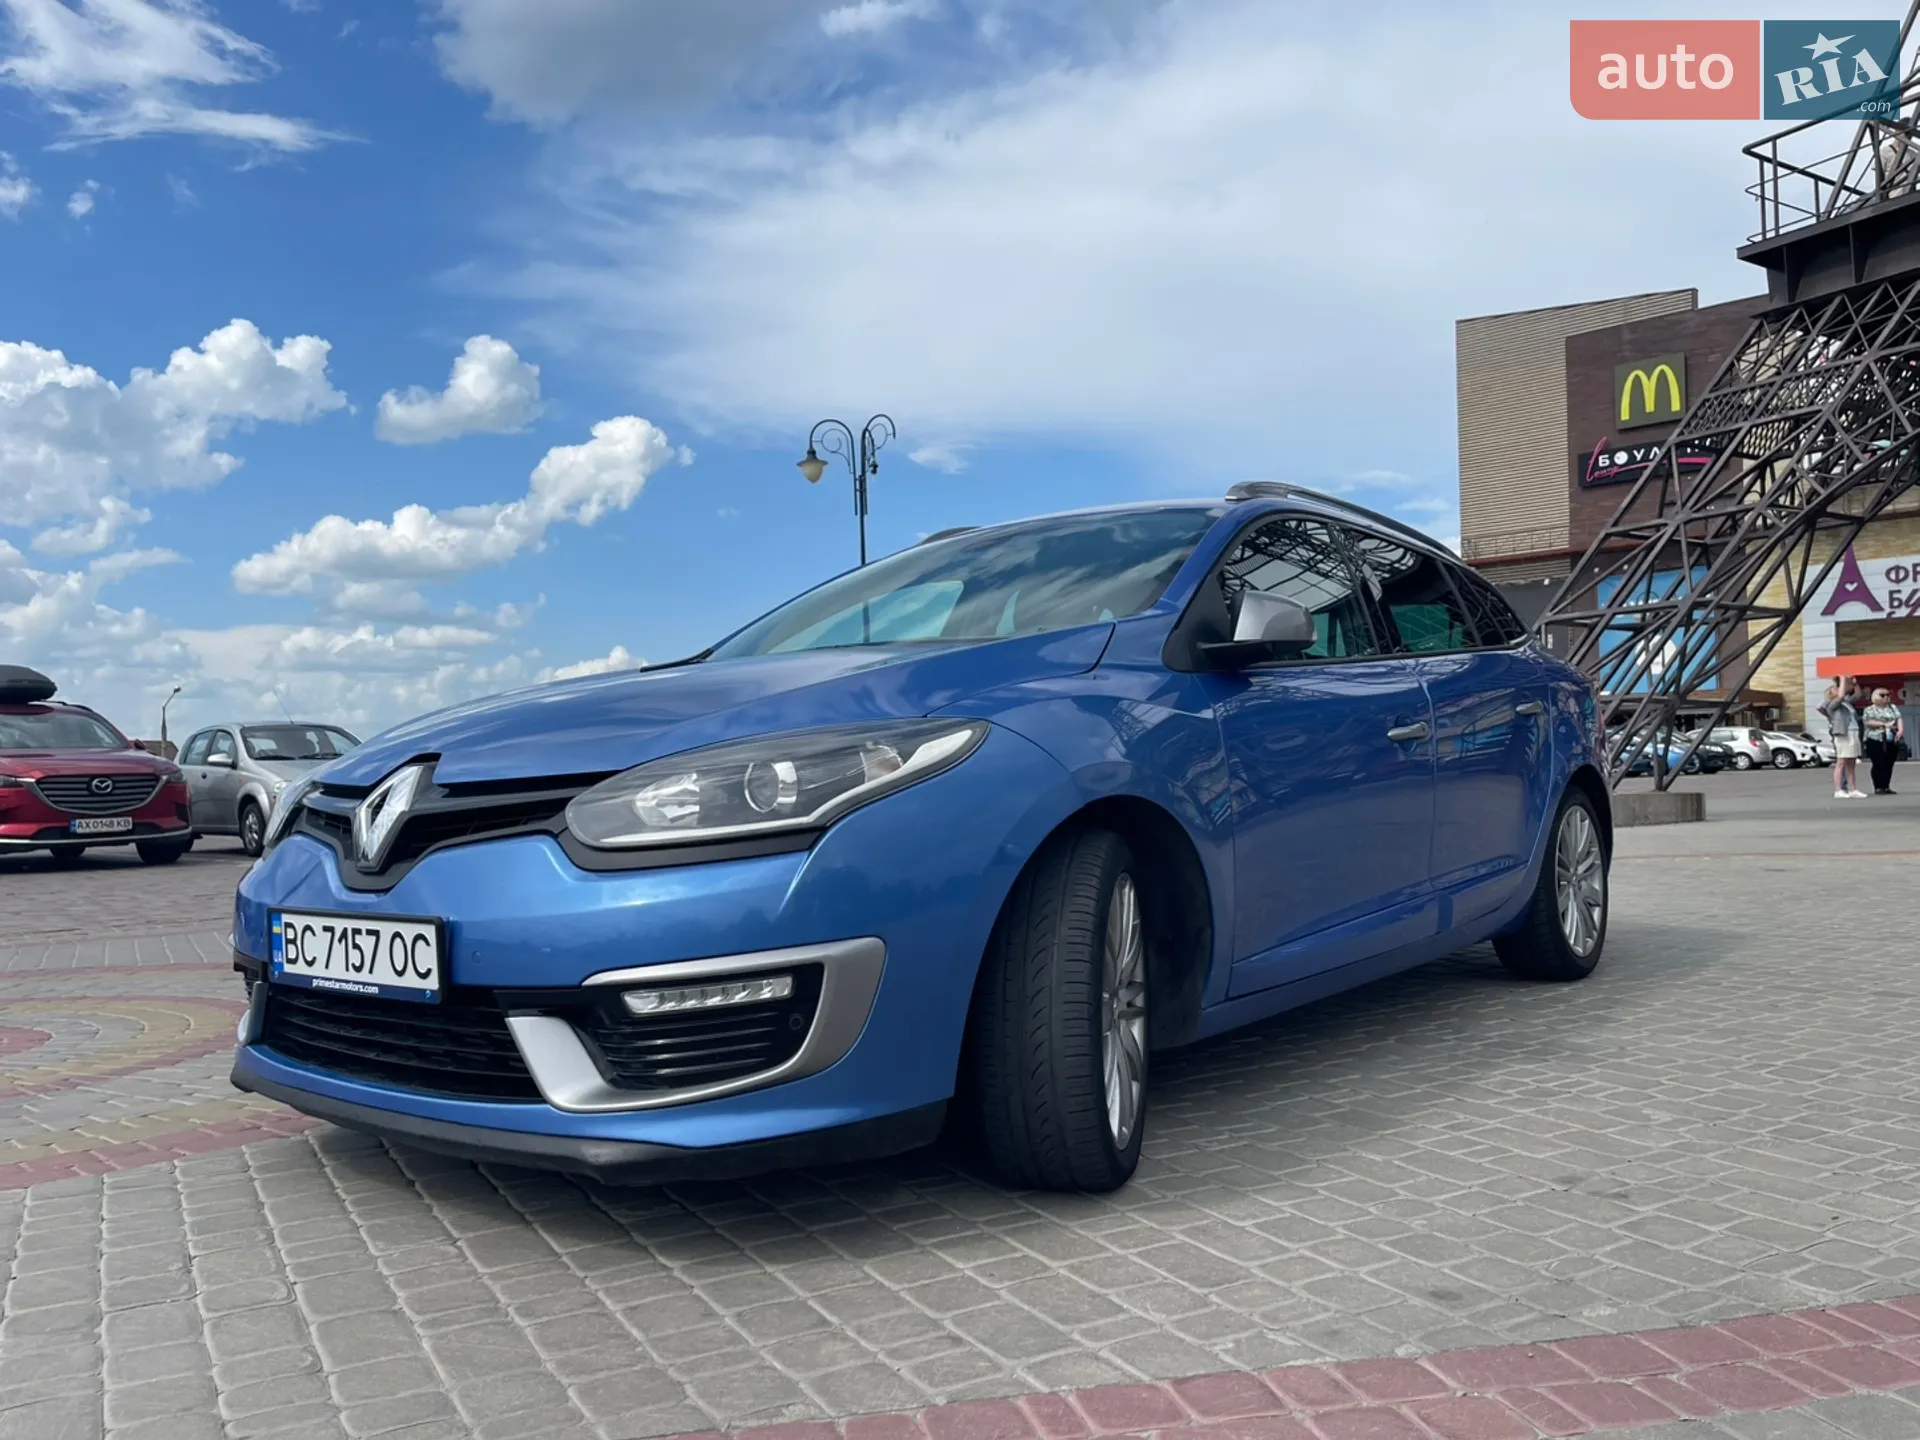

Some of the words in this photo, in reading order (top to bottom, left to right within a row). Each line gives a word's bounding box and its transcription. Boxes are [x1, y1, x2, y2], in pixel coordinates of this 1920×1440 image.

[77, 820, 91, 829] AX
[92, 820, 115, 829] 0148
[283, 921, 317, 967] BC
[322, 925, 381, 975] 7157
[389, 930, 433, 980] OC
[312, 977, 379, 994] primestarmotors.com
